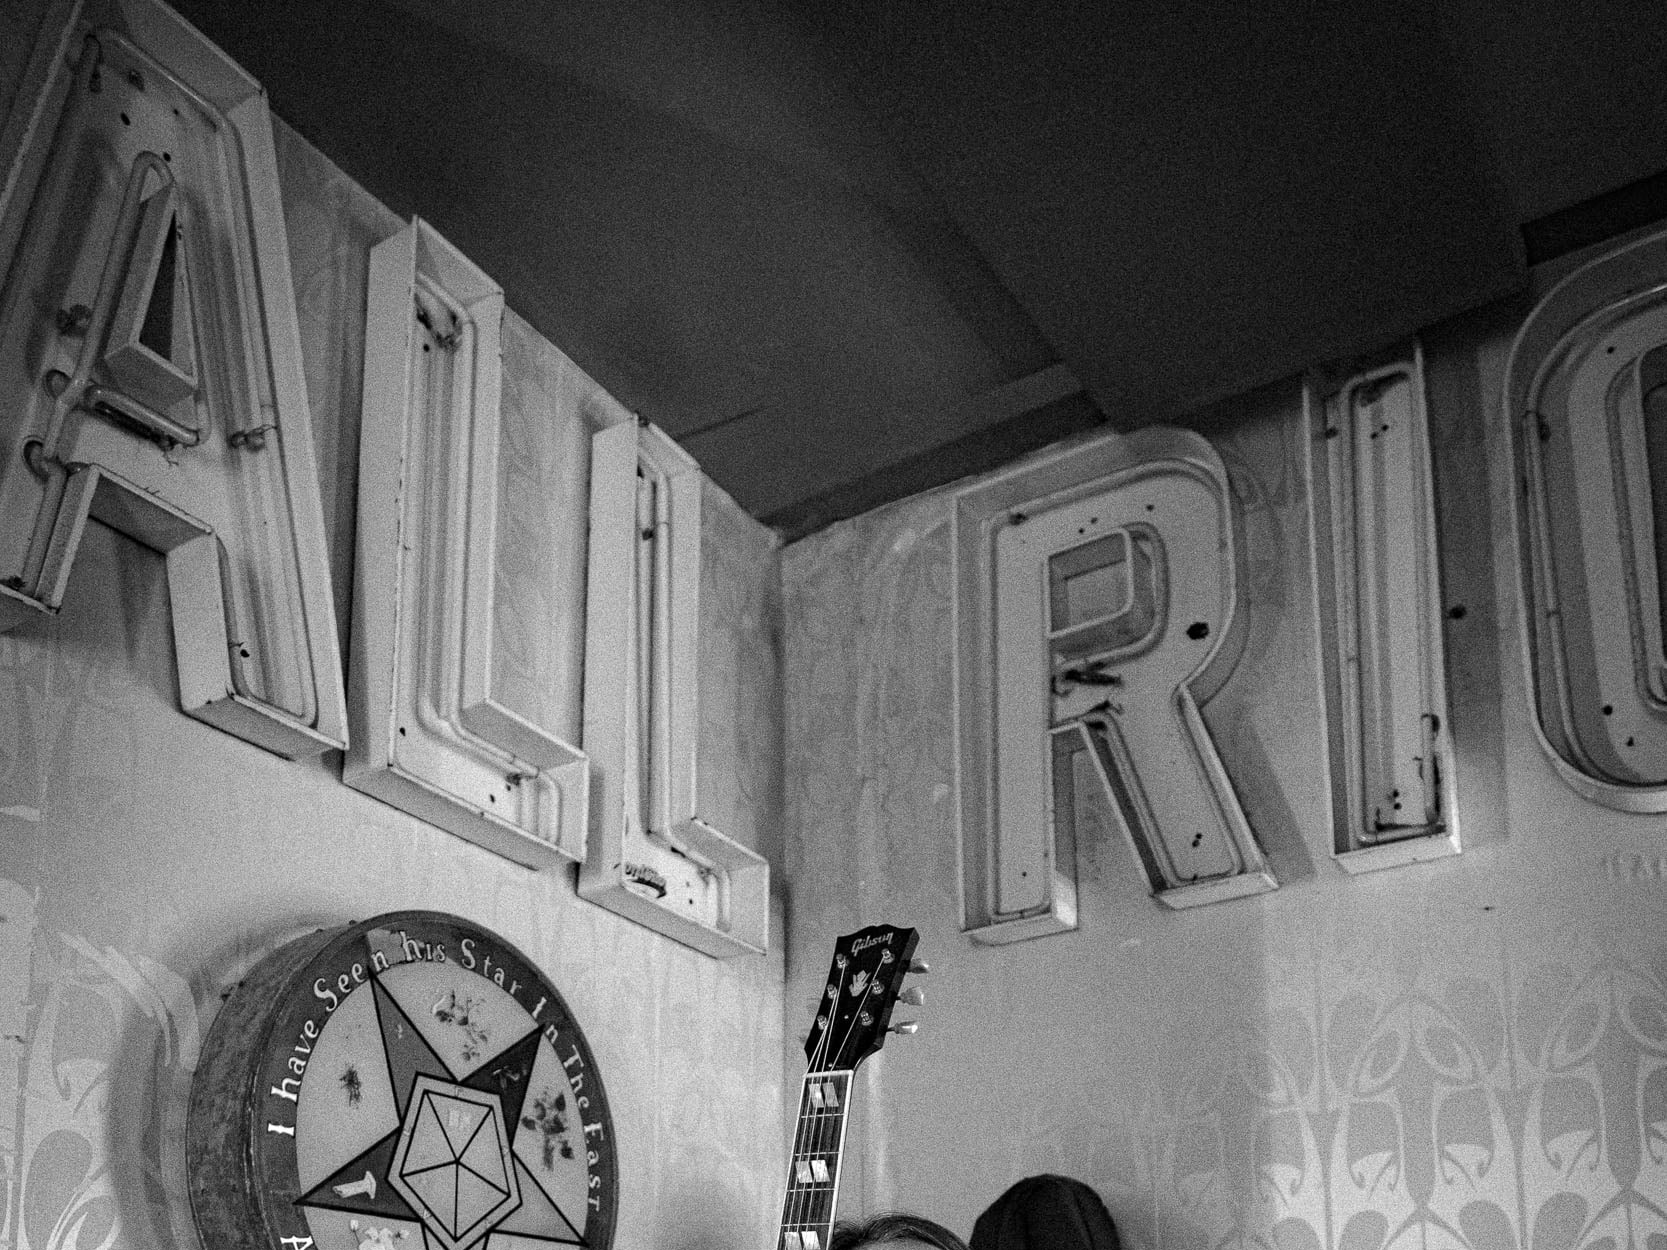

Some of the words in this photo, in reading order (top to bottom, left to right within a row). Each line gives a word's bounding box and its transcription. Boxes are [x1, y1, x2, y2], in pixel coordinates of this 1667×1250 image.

[0, 0, 768, 959] ALL
[461, 938, 522, 995] Star
[851, 931, 893, 957] Gibson
[313, 950, 390, 1012] Seen
[532, 996, 559, 1045] In
[270, 1020, 319, 1103] have
[563, 1044, 590, 1109] The
[267, 1122, 295, 1137] I
